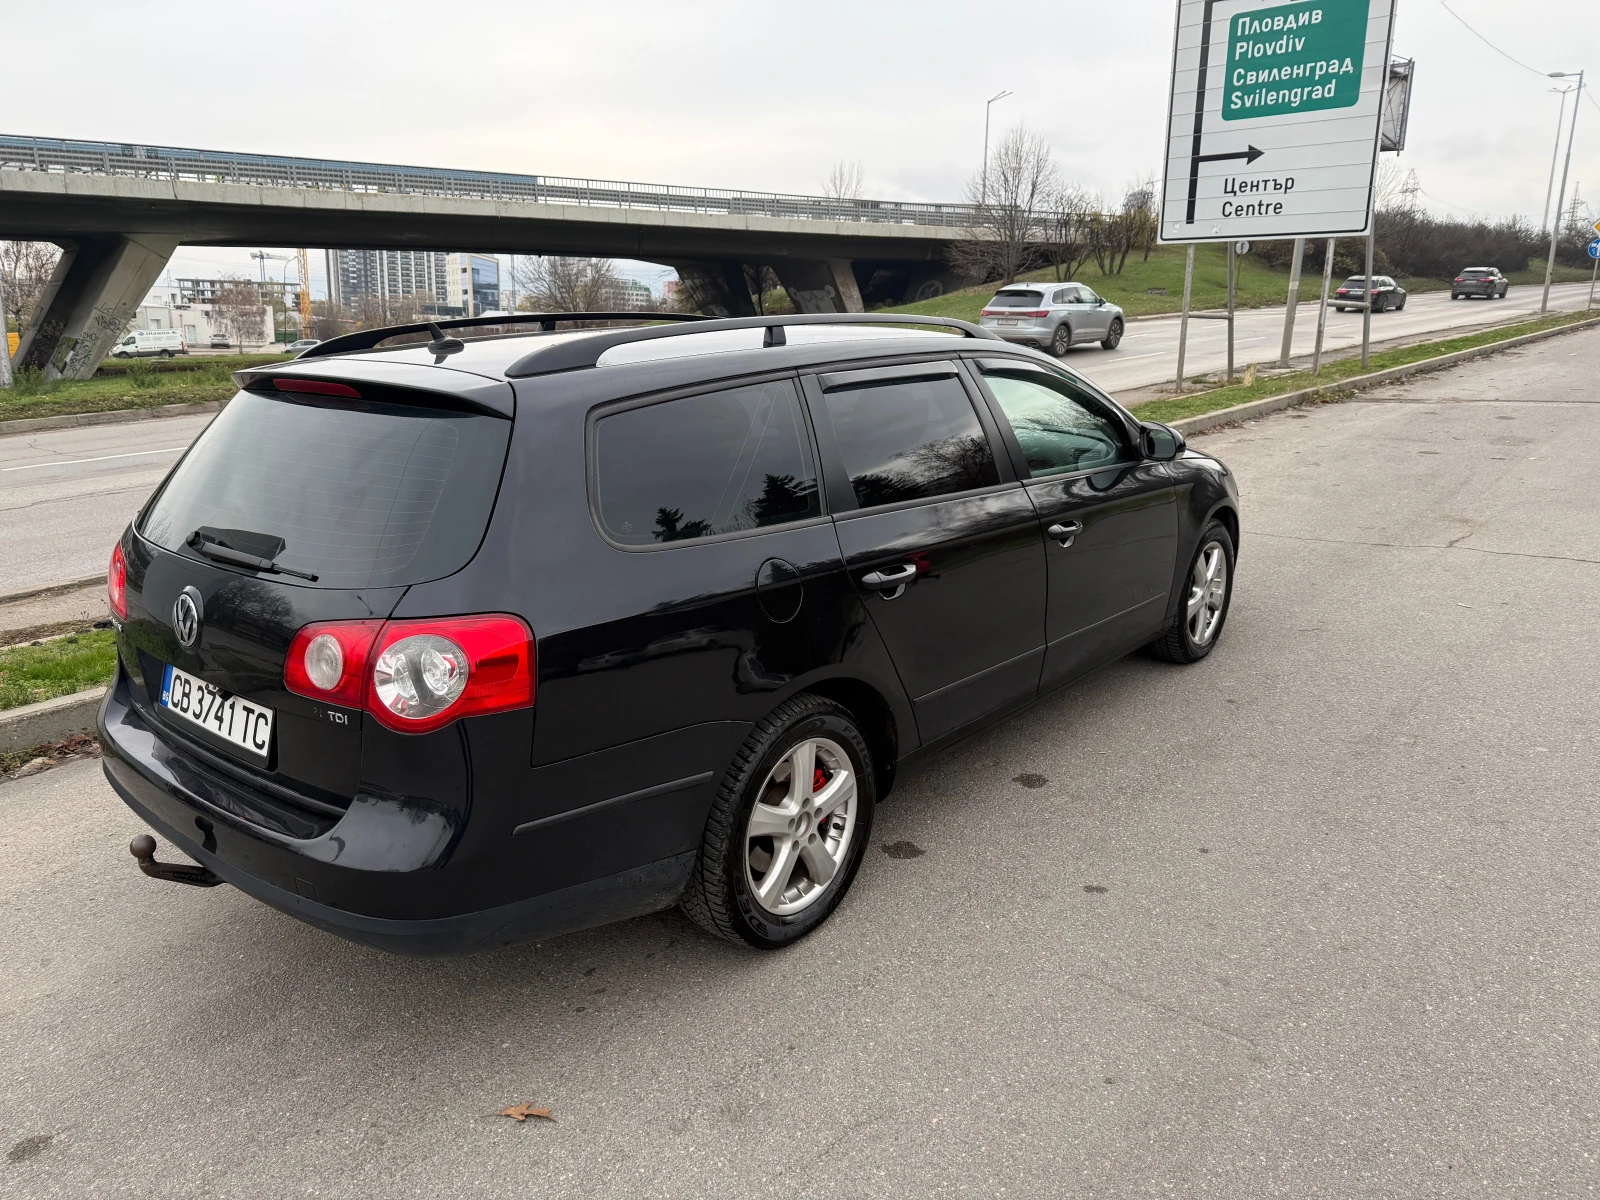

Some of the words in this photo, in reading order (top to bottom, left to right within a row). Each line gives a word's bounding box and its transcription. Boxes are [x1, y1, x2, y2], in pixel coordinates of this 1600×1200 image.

[1236, 9, 1322, 37] Пловдив
[1234, 35, 1306, 61] Plovdiv
[1232, 57, 1354, 87] Свиленград
[1230, 79, 1336, 109] Svilengrad
[1223, 176, 1295, 197] Център
[1221, 200, 1283, 218] Centre
[327, 711, 348, 725] TDI
